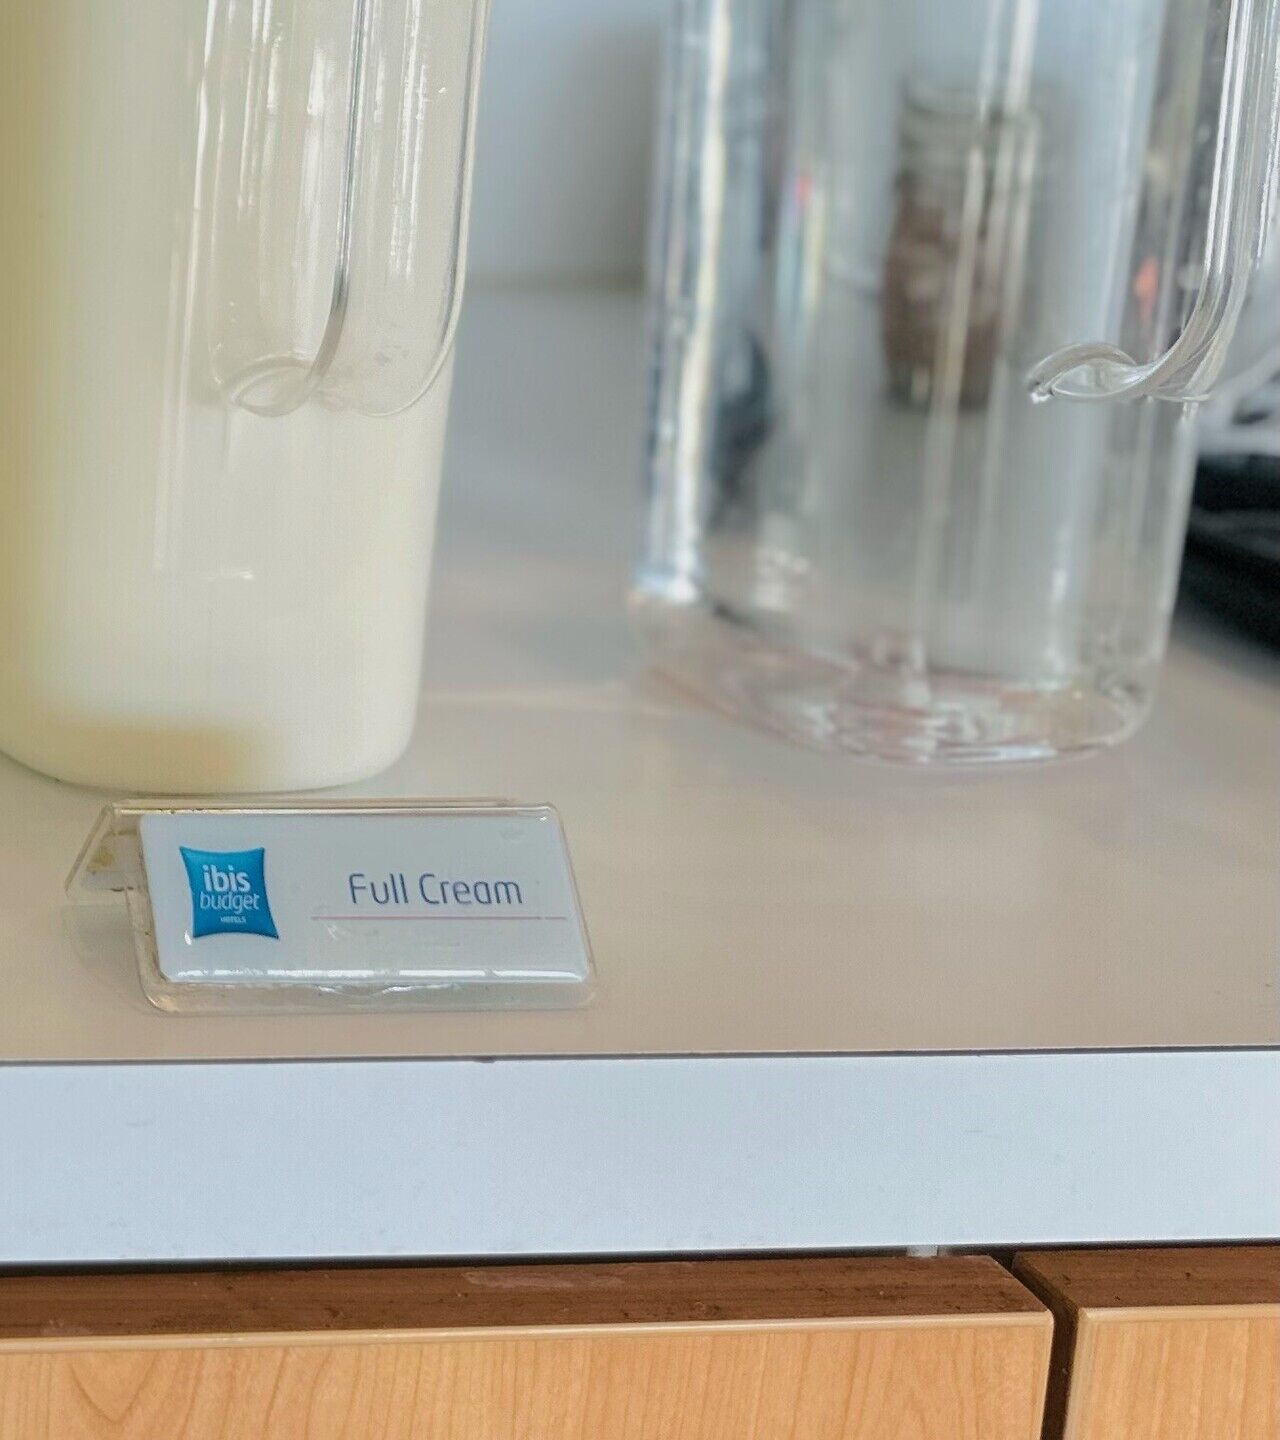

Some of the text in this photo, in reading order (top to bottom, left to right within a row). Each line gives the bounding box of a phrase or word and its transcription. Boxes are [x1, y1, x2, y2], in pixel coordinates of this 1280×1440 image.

[202, 864, 252, 893] ibis
[348, 872, 523, 906] Full Cream
[199, 891, 260, 915] budget
